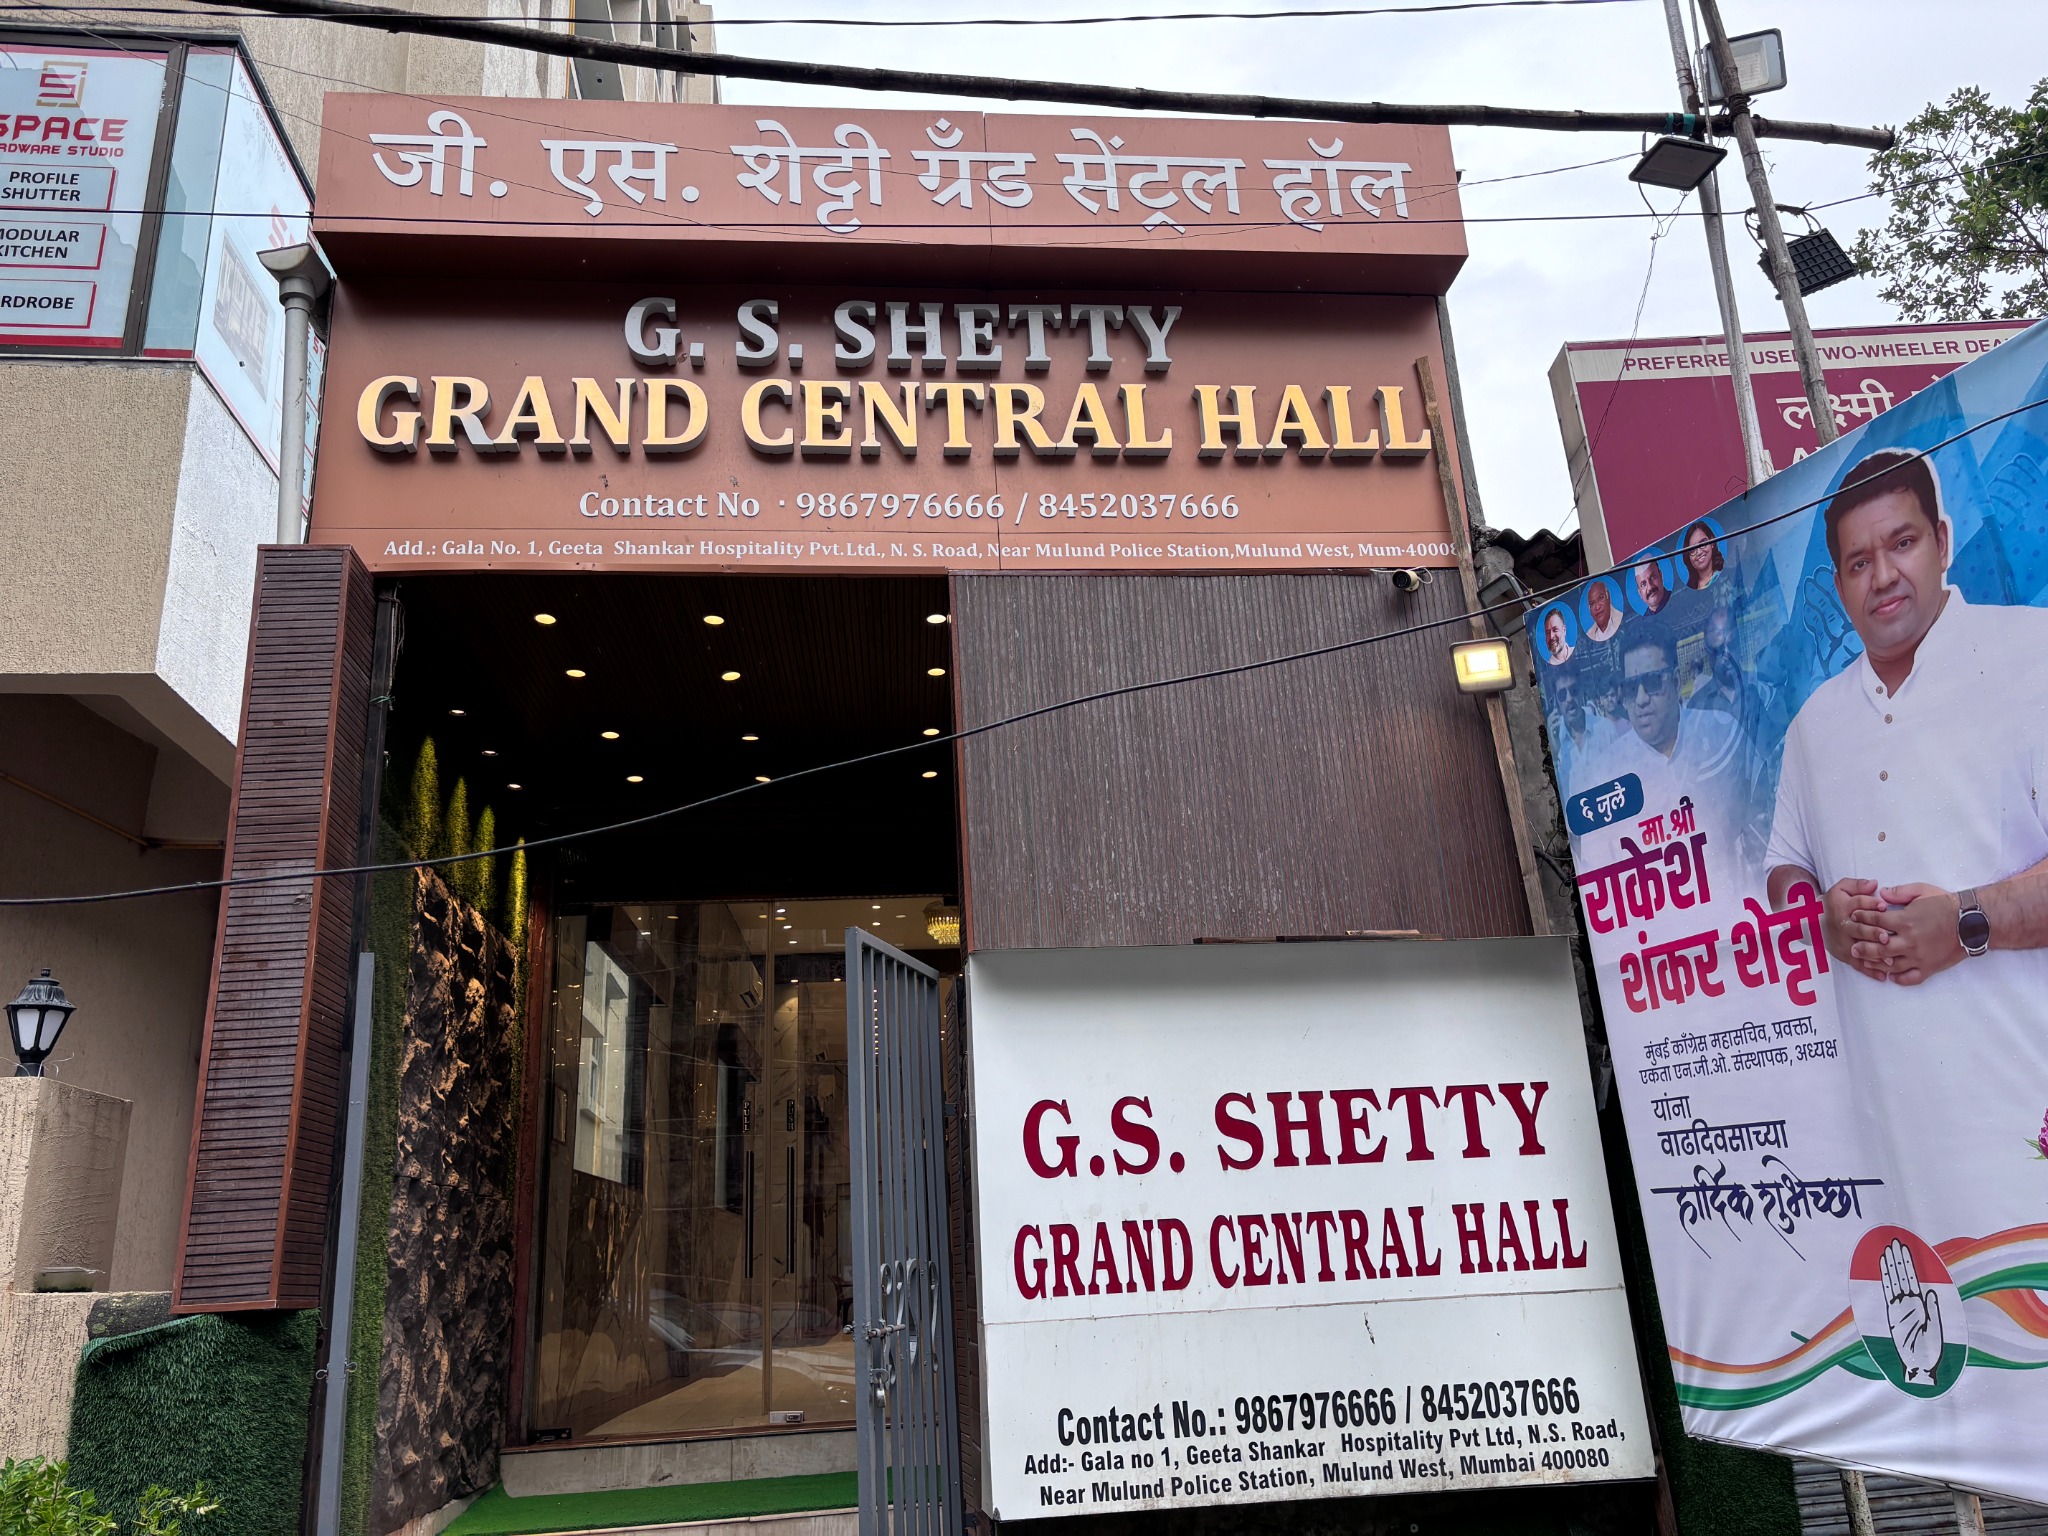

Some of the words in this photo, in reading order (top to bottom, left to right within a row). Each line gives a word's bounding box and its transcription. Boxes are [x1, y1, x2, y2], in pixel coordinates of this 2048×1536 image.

[67, 146, 124, 157] STUDIO
[369, 111, 508, 197] जी.
[540, 139, 700, 217] एस.
[730, 119, 891, 233] शेट्टी
[1054, 127, 1246, 234] सेंट्रल
[1263, 137, 1412, 232] हॉल
[1, 187, 80, 201] SHUTTER
[9, 171, 79, 185] PROFILE
[1, 296, 74, 309] RDROBE
[624, 297, 705, 367] G.
[736, 299, 803, 368] S.
[834, 300, 1182, 372] SHETTY
[1624, 353, 1730, 371] PREFERRE
[356, 375, 710, 455] GRAND
[741, 378, 1173, 458] CENTRAL
[1193, 384, 1432, 459] HALL
[579, 491, 708, 517] Contact
[717, 492, 760, 518] No
[796, 492, 1005, 519] 9867976666
[1038, 492, 1240, 519] 8452037666
[442, 540, 485, 556] Gala
[490, 541, 521, 556] No.
[527, 541, 543, 558] 1,
[548, 541, 603, 556] Geeta
[614, 540, 694, 556] Shankar
[700, 541, 803, 559] Hospitality
[890, 543, 908, 557] N.
[912, 543, 927, 557] S.
[932, 543, 983, 559] Road,
[987, 543, 1030, 558] Near
[1035, 542, 1104, 558] Mulund
[1110, 542, 1162, 558] Police
[1306, 543, 1354, 560] West,
[1580, 797, 1594, 821] ६
[1596, 782, 1626, 822] जुलै
[1576, 832, 1711, 934] राकेश
[1619, 931, 1725, 1014] शंकर
[1730, 881, 1829, 1007] शेट्टी
[1639, 1066, 1672, 1085] एकता
[1731, 1047, 1793, 1072] संस्थापक,
[1795, 1039, 1838, 1062] अध्यक्ष
[1644, 1037, 1671, 1065] मुंबई
[1709, 1021, 1771, 1050] महासचिव,
[1772, 1016, 1817, 1040] प्रवक्ता,
[1023, 1096, 1186, 1179] G.S.
[1215, 1081, 1549, 1172] SHETTY
[1651, 1092, 1692, 1121] यांना
[1657, 1118, 1789, 1157] वाढदिवसाच्या
[1650, 1159, 1754, 1259] हार्दिक
[1752, 1155, 1884, 1261] शुभेच्छा
[1013, 1217, 1194, 1300] GRAND
[1209, 1205, 1442, 1290] CENTRAL
[1451, 1198, 1587, 1275] HALL
[1057, 1403, 1165, 1447] Contact
[1234, 1387, 1396, 1434] 9867976666
[1420, 1376, 1580, 1422] 8452037666
[1082, 1450, 1124, 1472] Gala
[1131, 1452, 1154, 1469] no
[1161, 1446, 1179, 1470] 1,
[1187, 1444, 1242, 1466] Geeta
[1248, 1438, 1325, 1463] Shankar
[1341, 1428, 1443, 1456] Hospitality
[1450, 1427, 1480, 1448] Pvt
[1486, 1425, 1522, 1448] Ltd,
[1527, 1422, 1566, 1445] N.S.
[1571, 1418, 1626, 1442] Road,
[1040, 1485, 1086, 1506] Near
[1092, 1478, 1165, 1503] Mulund
[1171, 1474, 1232, 1497] Police
[1239, 1468, 1314, 1491] Station,
[1322, 1459, 1393, 1483] Mulund
[1398, 1457, 1454, 1480] West,
[1459, 1451, 1535, 1476] Mumbai
[1541, 1447, 1610, 1471] 400080
